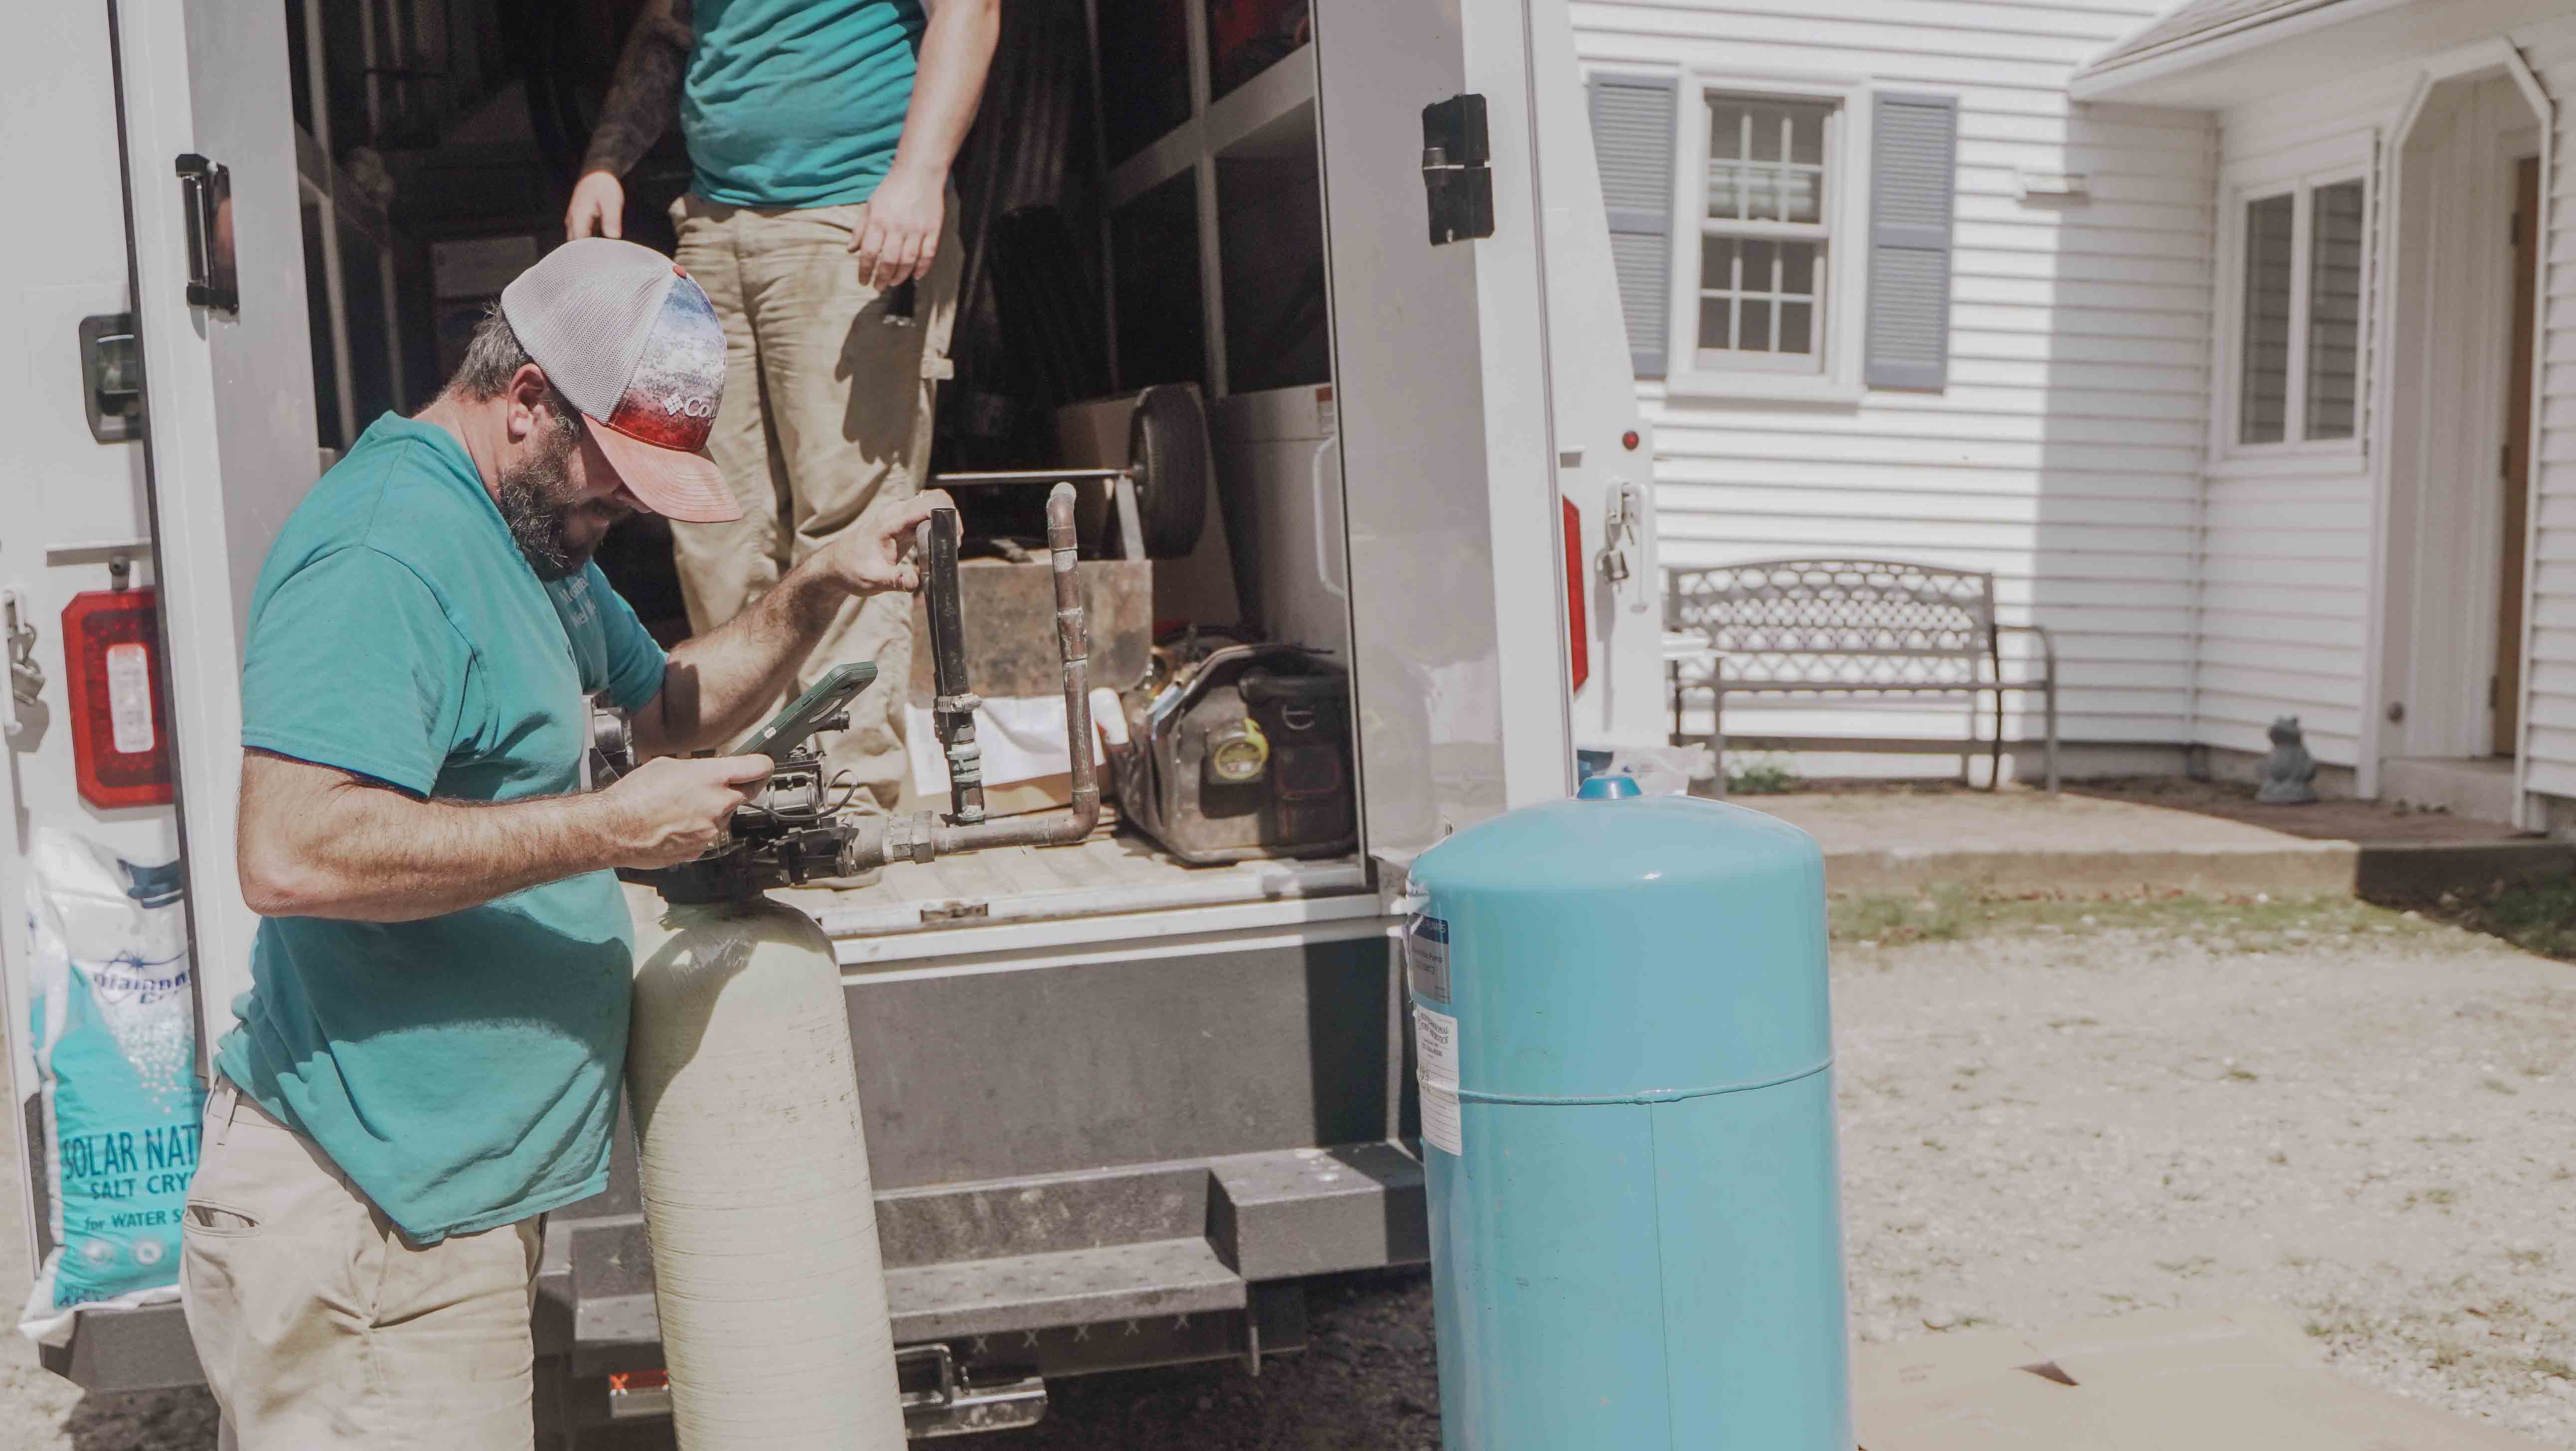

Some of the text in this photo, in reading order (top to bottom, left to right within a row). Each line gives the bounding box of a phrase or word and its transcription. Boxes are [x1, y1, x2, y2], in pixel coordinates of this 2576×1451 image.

[64, 1123, 203, 1180] SOLAR NAT
[90, 1171, 195, 1199] SALT CRY
[84, 1208, 185, 1230] for WATER S
